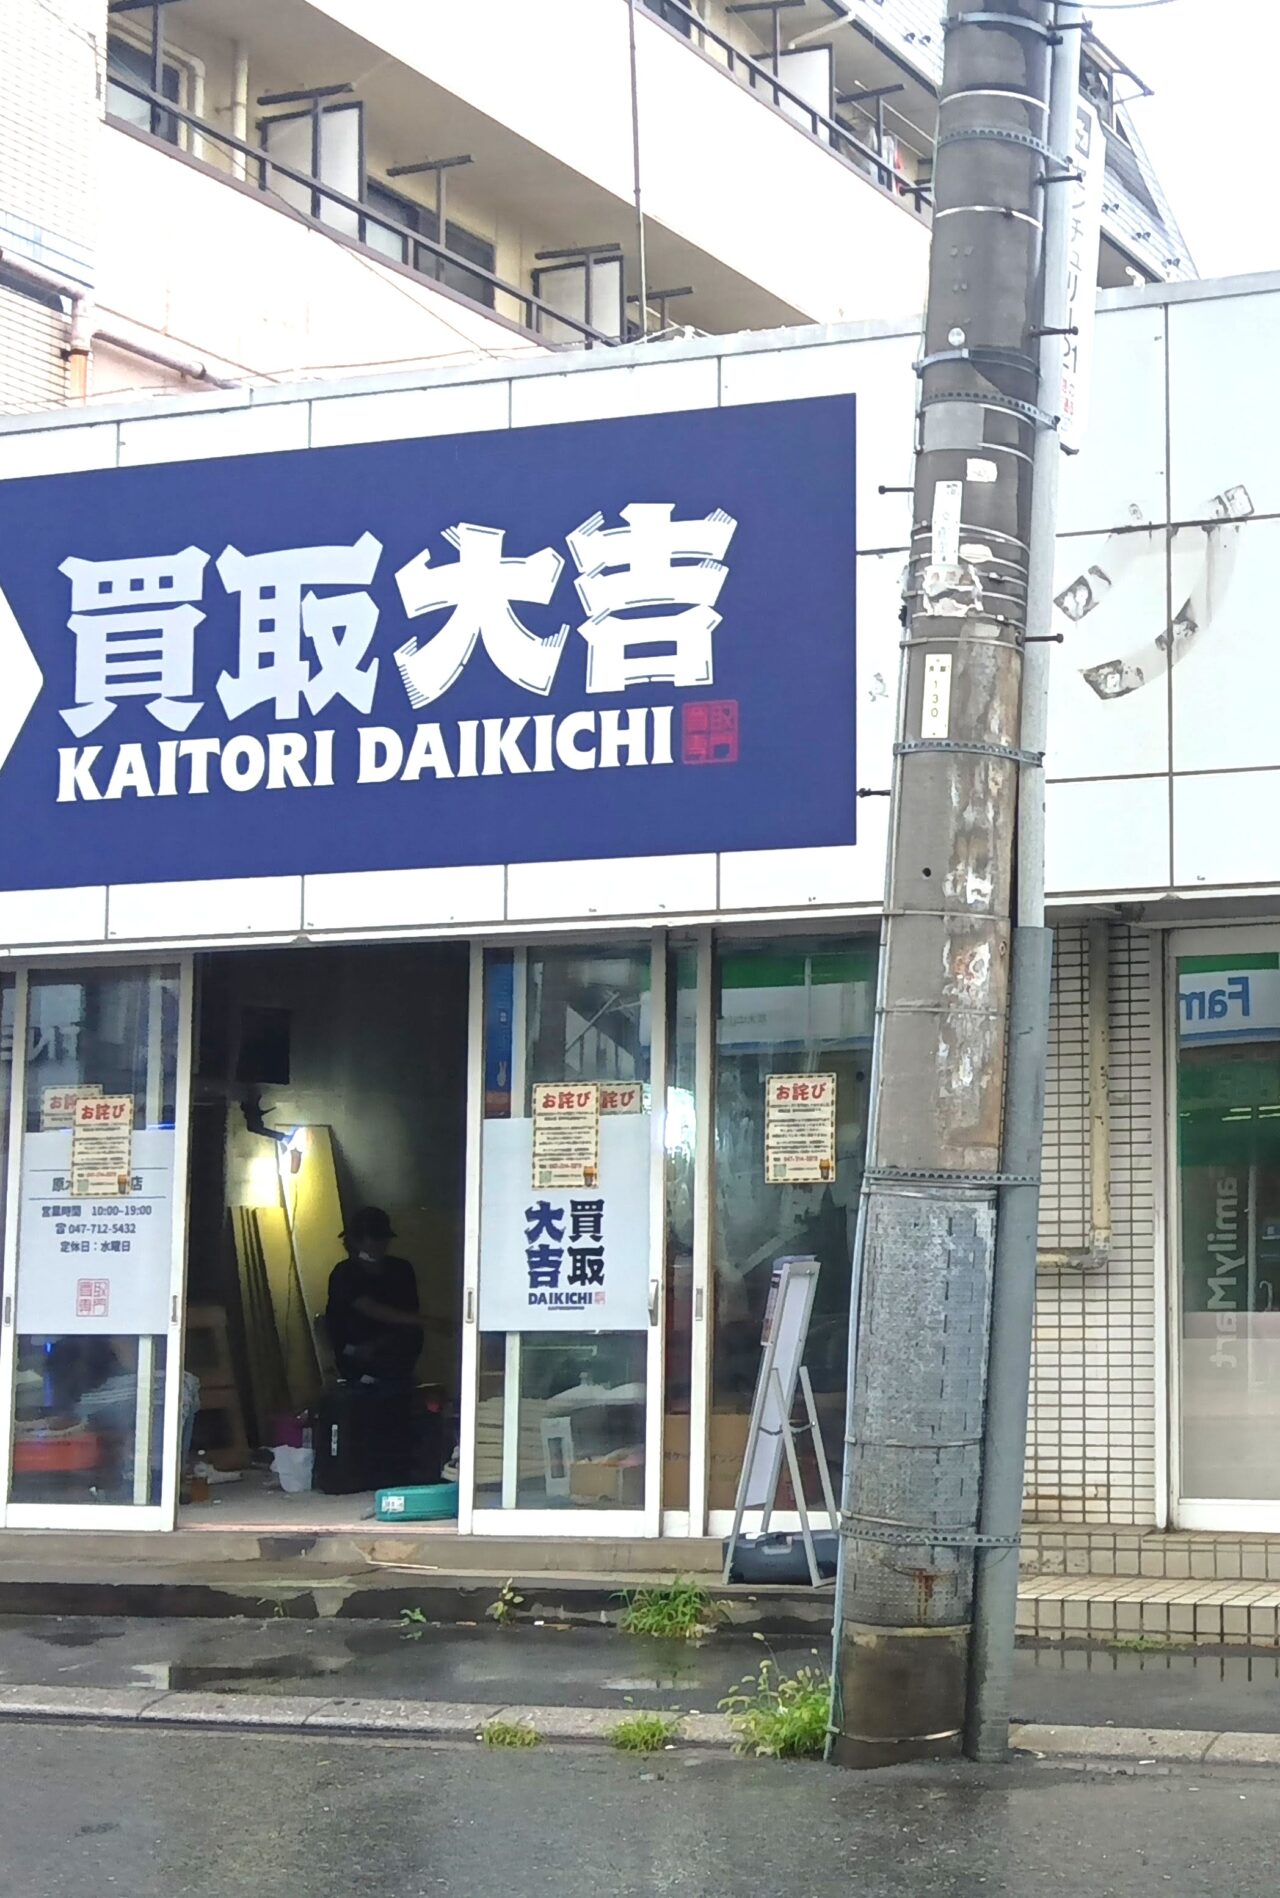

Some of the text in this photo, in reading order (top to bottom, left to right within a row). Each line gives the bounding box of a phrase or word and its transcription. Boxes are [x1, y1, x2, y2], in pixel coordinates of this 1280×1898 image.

[58, 502, 738, 740] 買取大吉
[56, 706, 674, 803] KAITORI DAIKICHI
[542, 1091, 592, 1109] お詫び
[776, 1082, 827, 1101] お詫び
[81, 1103, 127, 1120] お詫び
[528, 1292, 593, 1305] DAIKICHI
